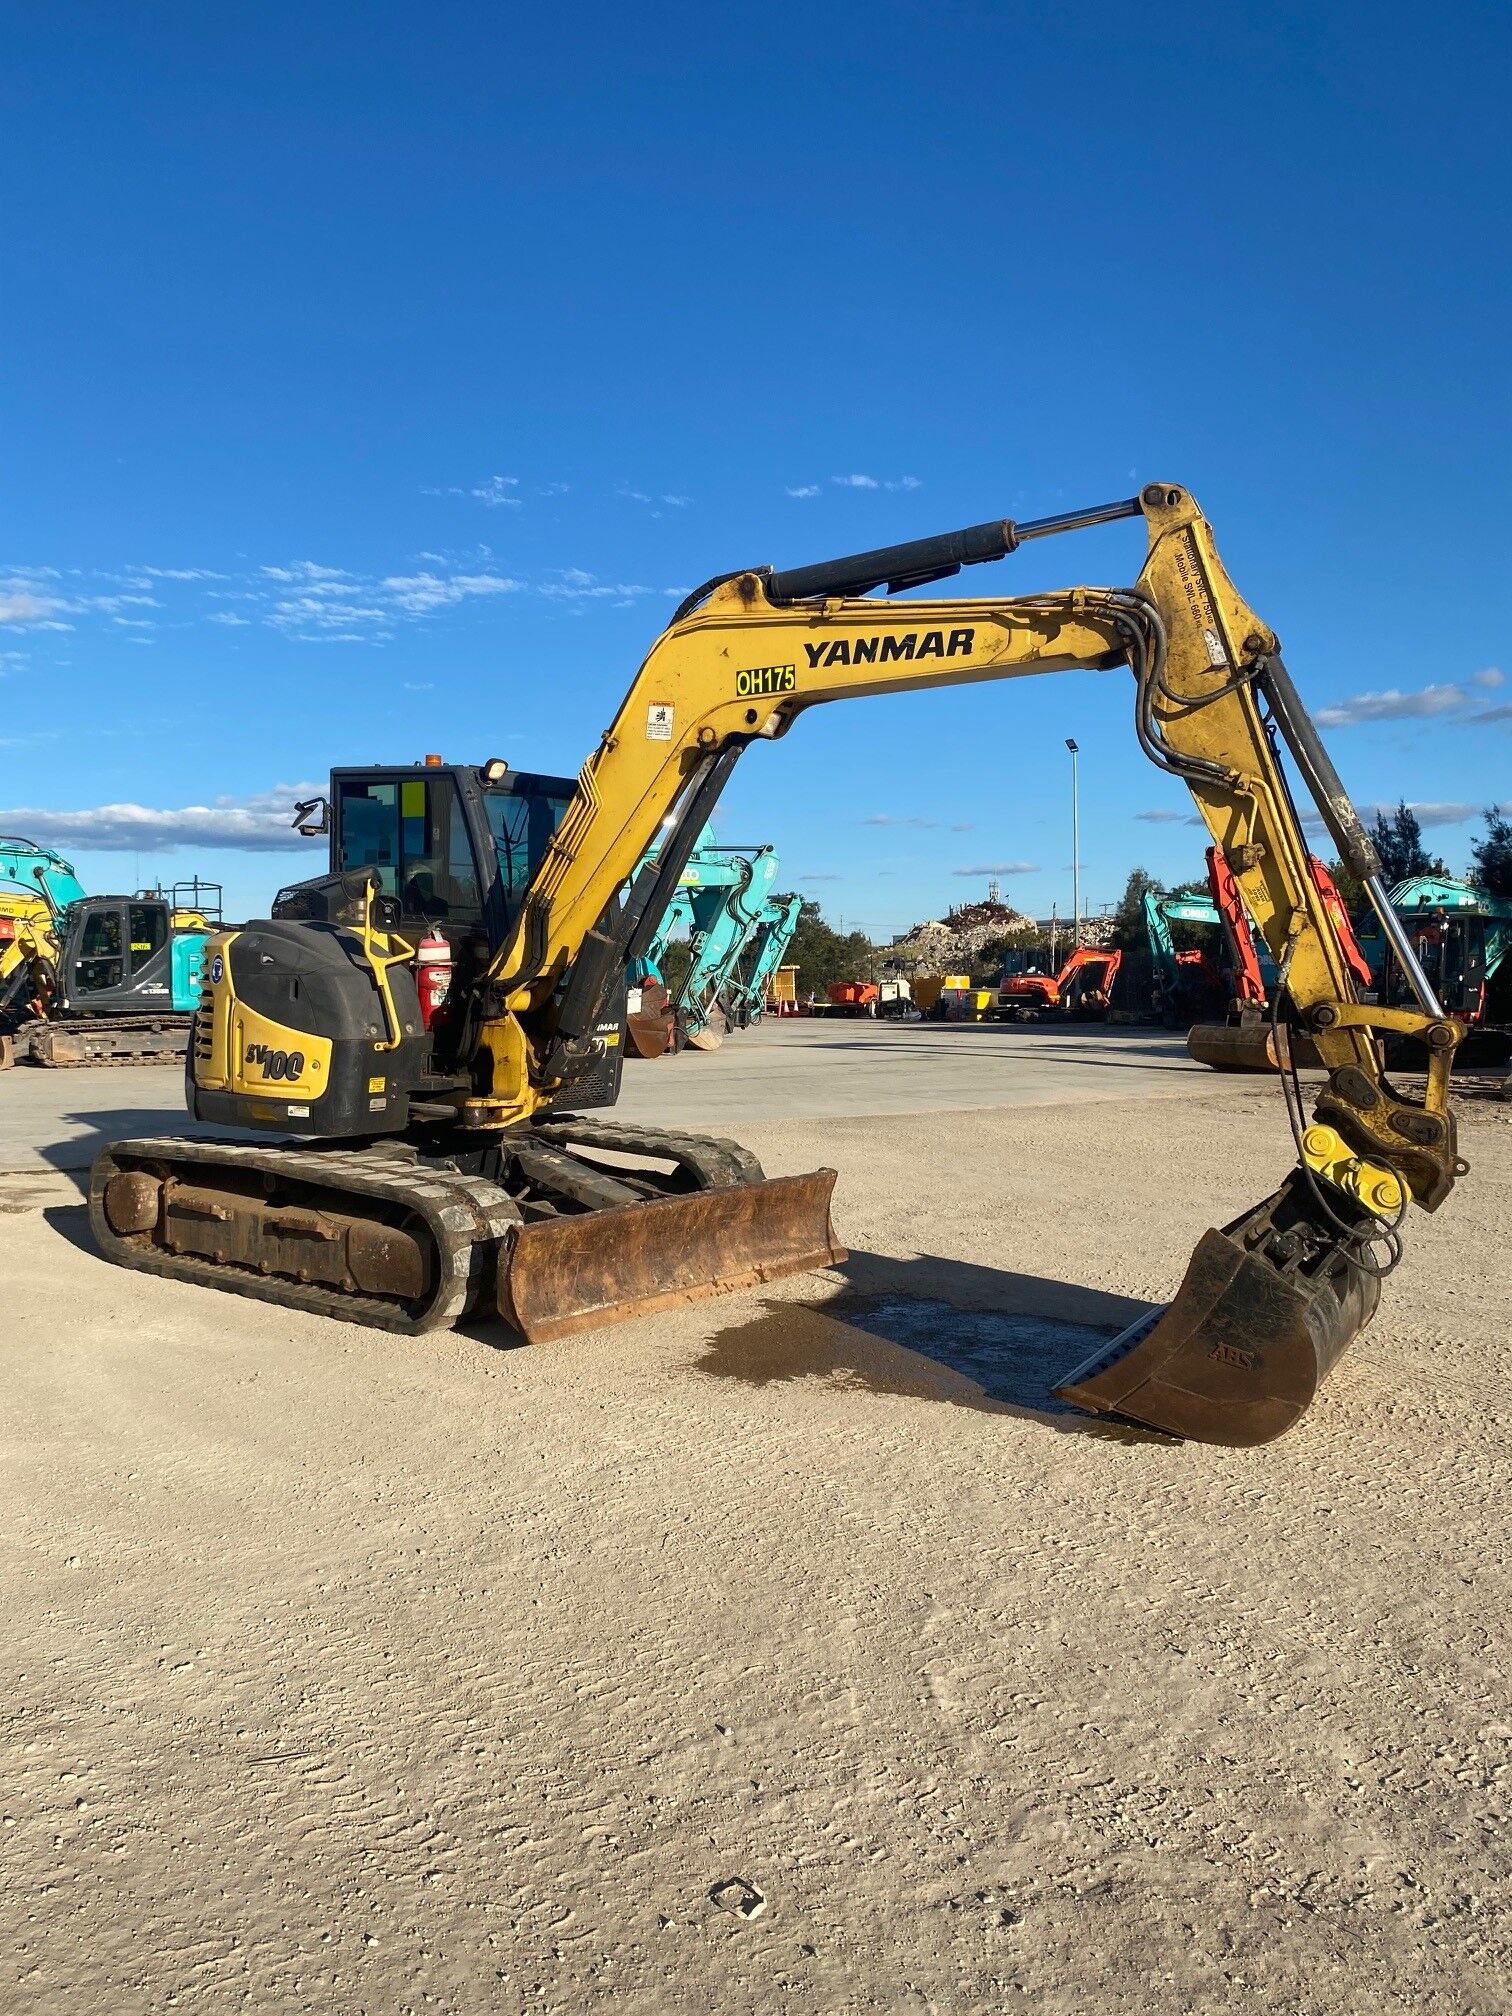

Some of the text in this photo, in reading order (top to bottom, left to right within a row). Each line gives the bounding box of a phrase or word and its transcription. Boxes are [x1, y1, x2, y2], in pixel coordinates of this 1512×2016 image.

[1175, 554, 1189, 582] Mobile
[1182, 535, 1200, 577] Stationary
[803, 628, 975, 668] YANMAR
[736, 665, 795, 696] OH175
